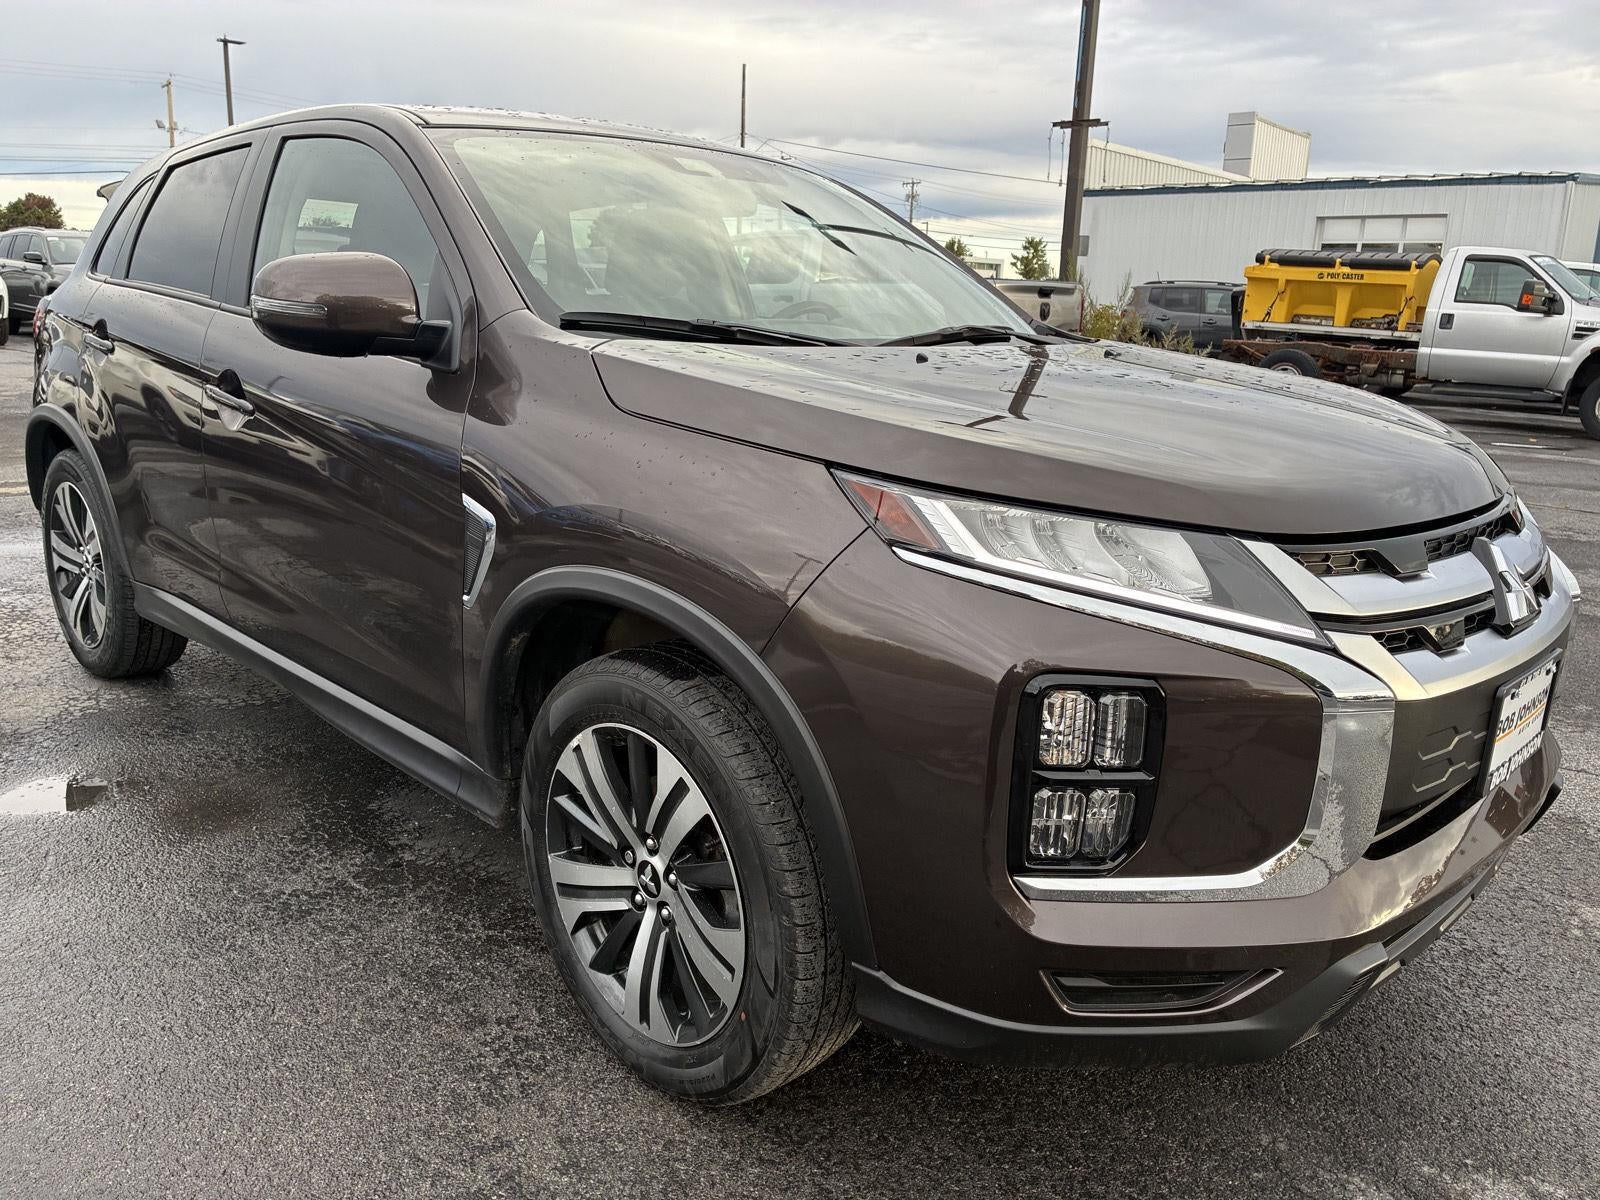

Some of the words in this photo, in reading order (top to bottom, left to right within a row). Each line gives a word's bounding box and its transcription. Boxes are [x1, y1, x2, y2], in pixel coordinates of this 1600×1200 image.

[1326, 272, 1340, 280] POLY
[1496, 711, 1517, 738] BOB
[1513, 687, 1549, 731] JOHNSON
[1489, 761, 1509, 792] BOB
[1505, 731, 1545, 782] JOHNSON
